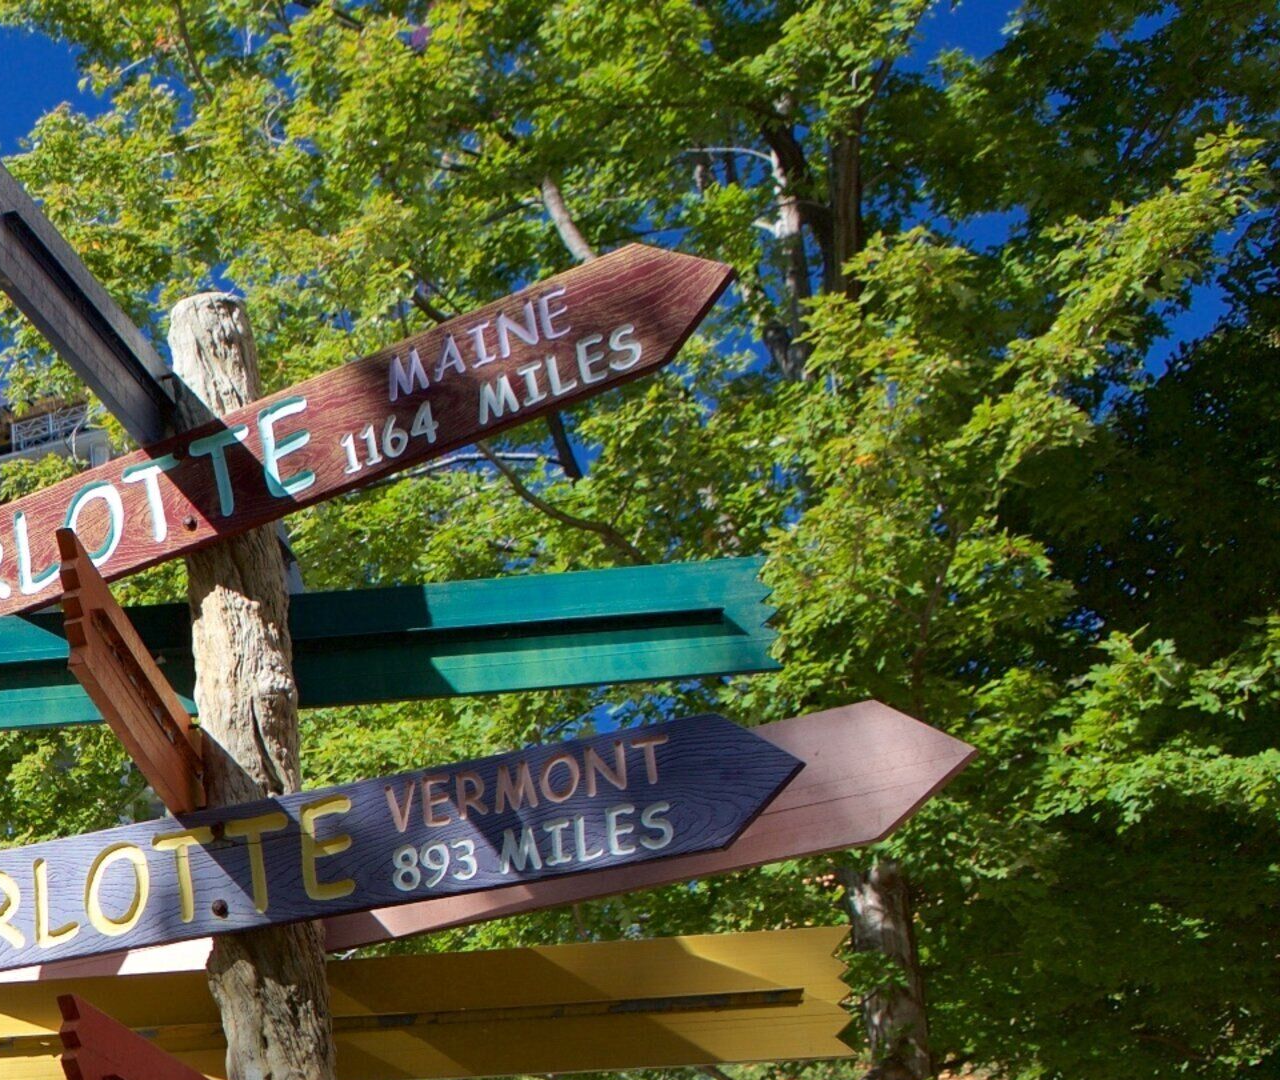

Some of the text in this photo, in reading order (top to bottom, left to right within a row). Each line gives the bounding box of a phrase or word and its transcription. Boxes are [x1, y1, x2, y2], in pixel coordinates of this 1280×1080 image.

[389, 284, 571, 402] MAINE
[340, 322, 642, 475] 1164 MILES
[384, 734, 669, 833] VERMONT
[392, 800, 674, 891] 893 MILES
